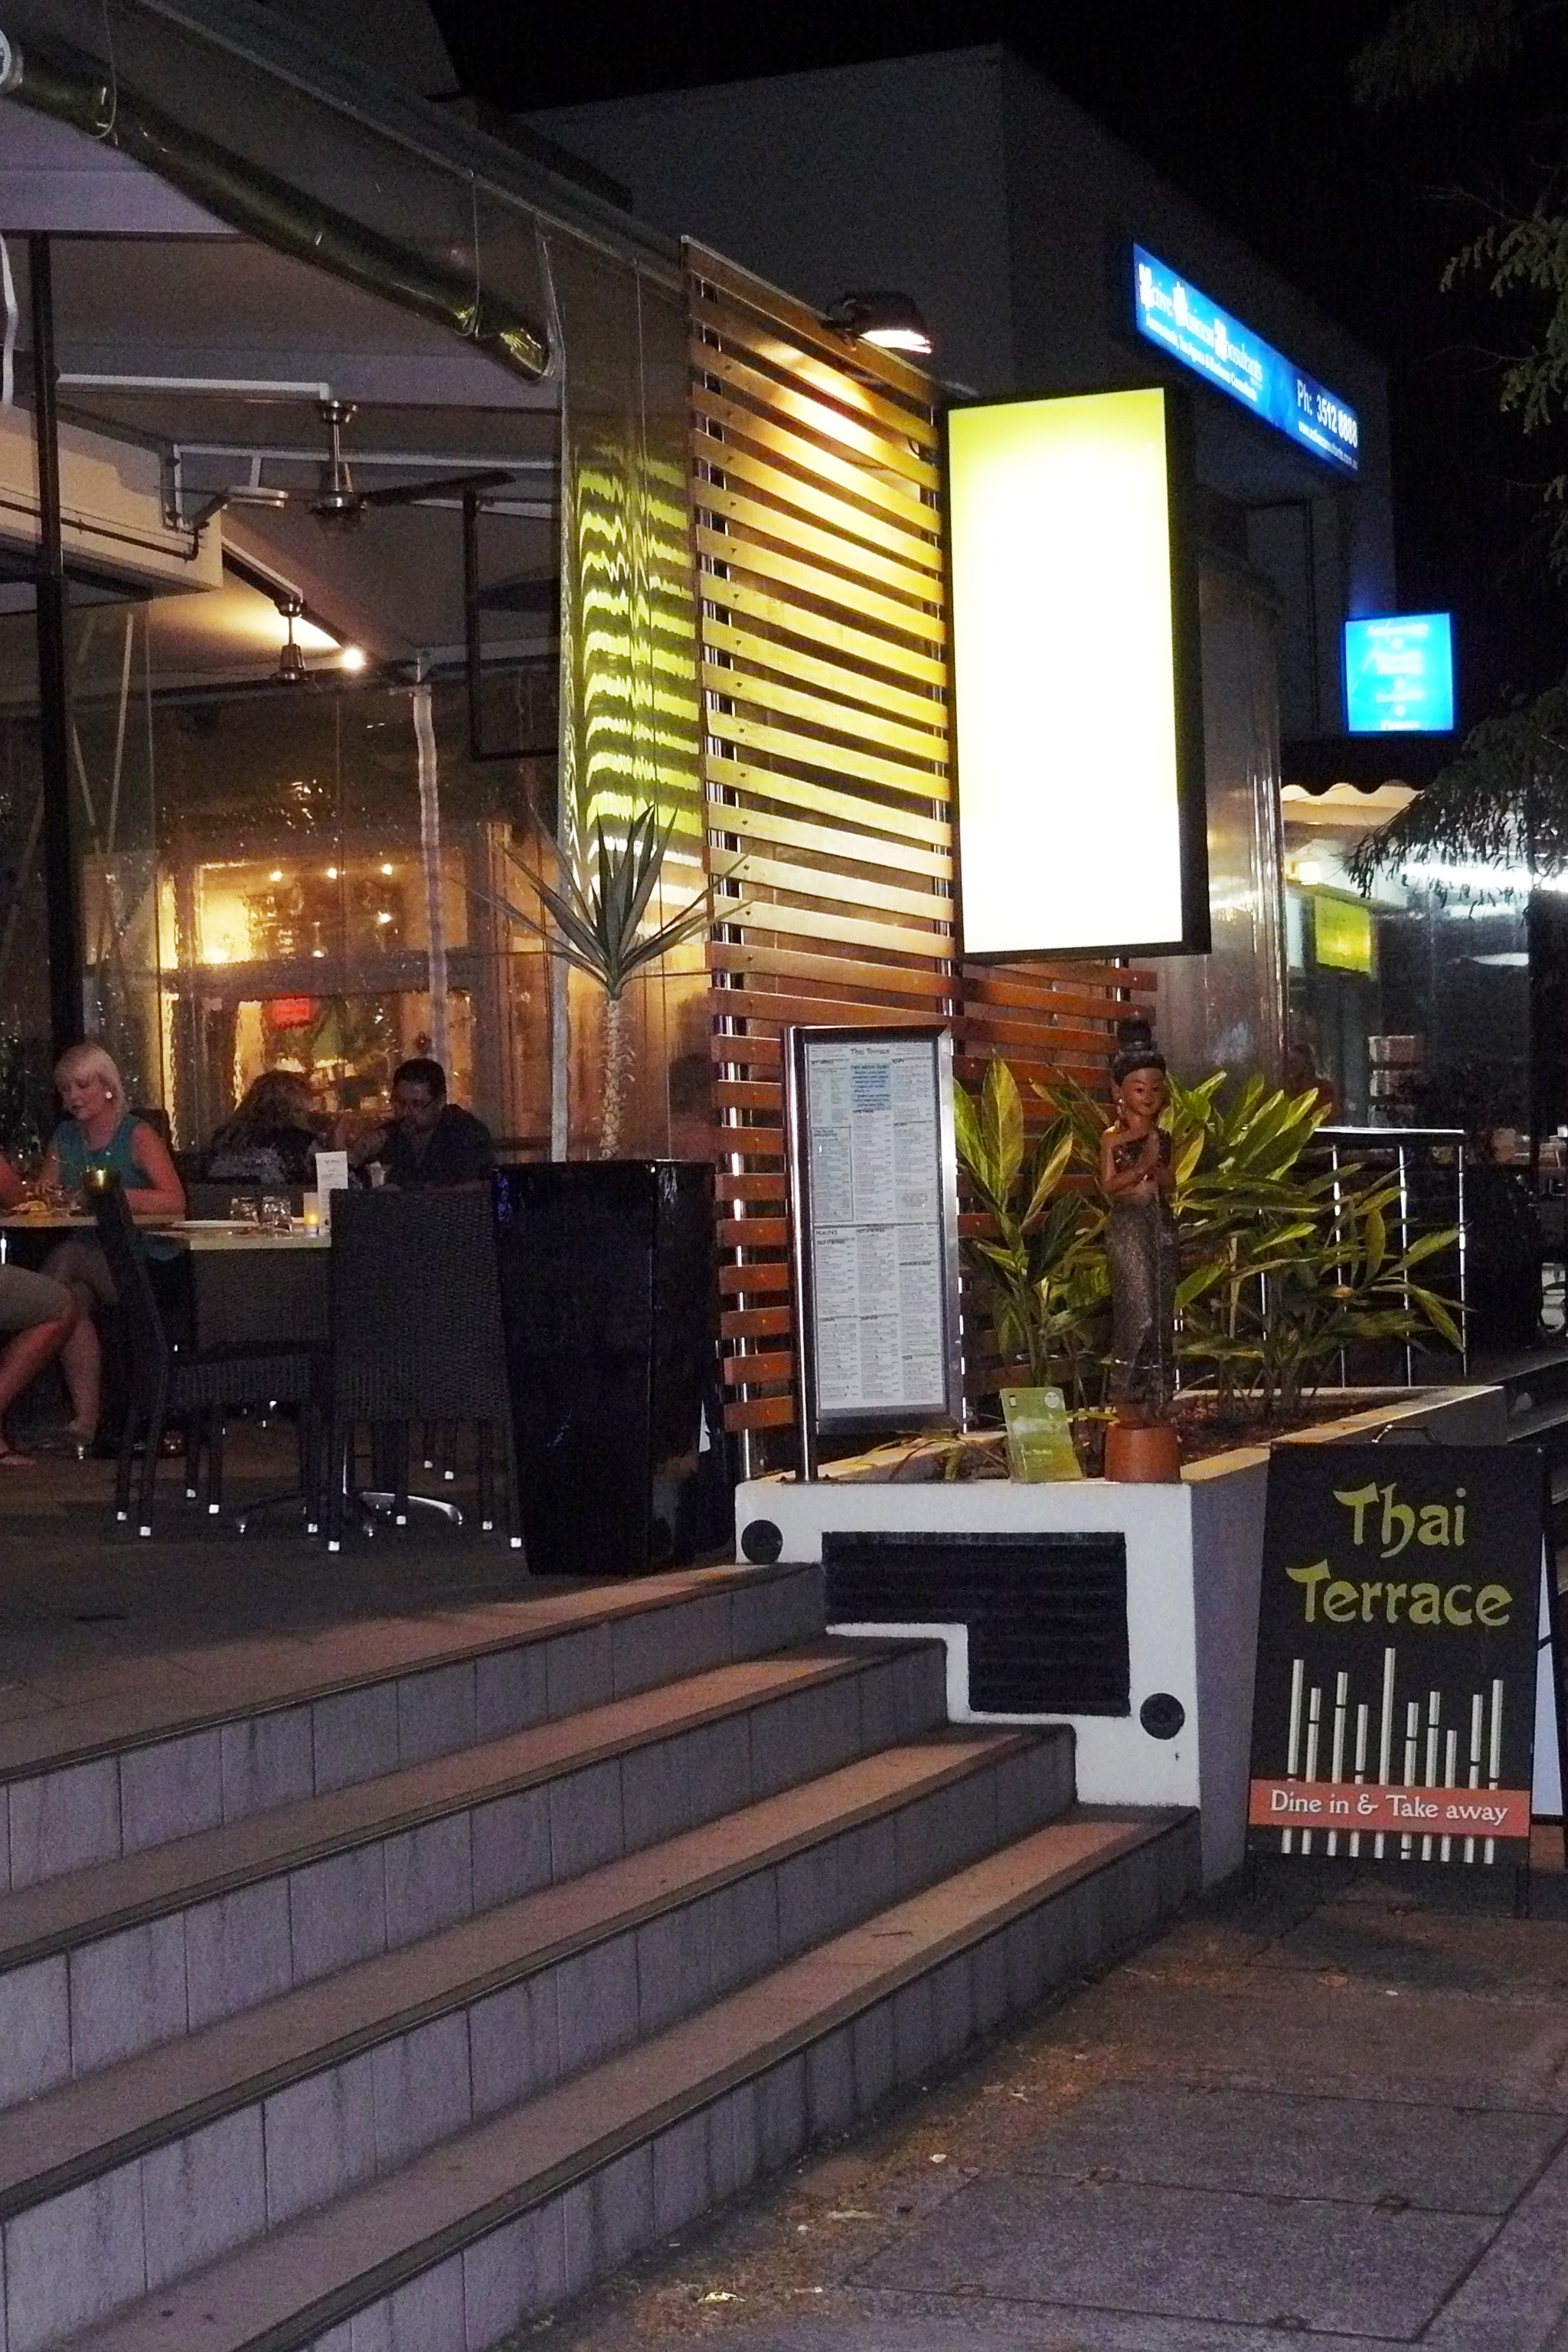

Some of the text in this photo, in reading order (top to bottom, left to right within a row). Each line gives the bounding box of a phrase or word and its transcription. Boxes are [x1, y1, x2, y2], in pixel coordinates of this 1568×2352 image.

[1138, 263, 1173, 317] ctive
[1173, 282, 1214, 348] usiness
[1214, 318, 1263, 382] onsultants
[1297, 379, 1313, 416] Ph:
[1317, 394, 1338, 433] 3512
[1338, 410, 1358, 449] 8888
[1333, 1481, 1466, 1558] Thai
[1285, 1559, 1513, 1627] Terrace
[1270, 1789, 1508, 1825] Dine in & Take away
